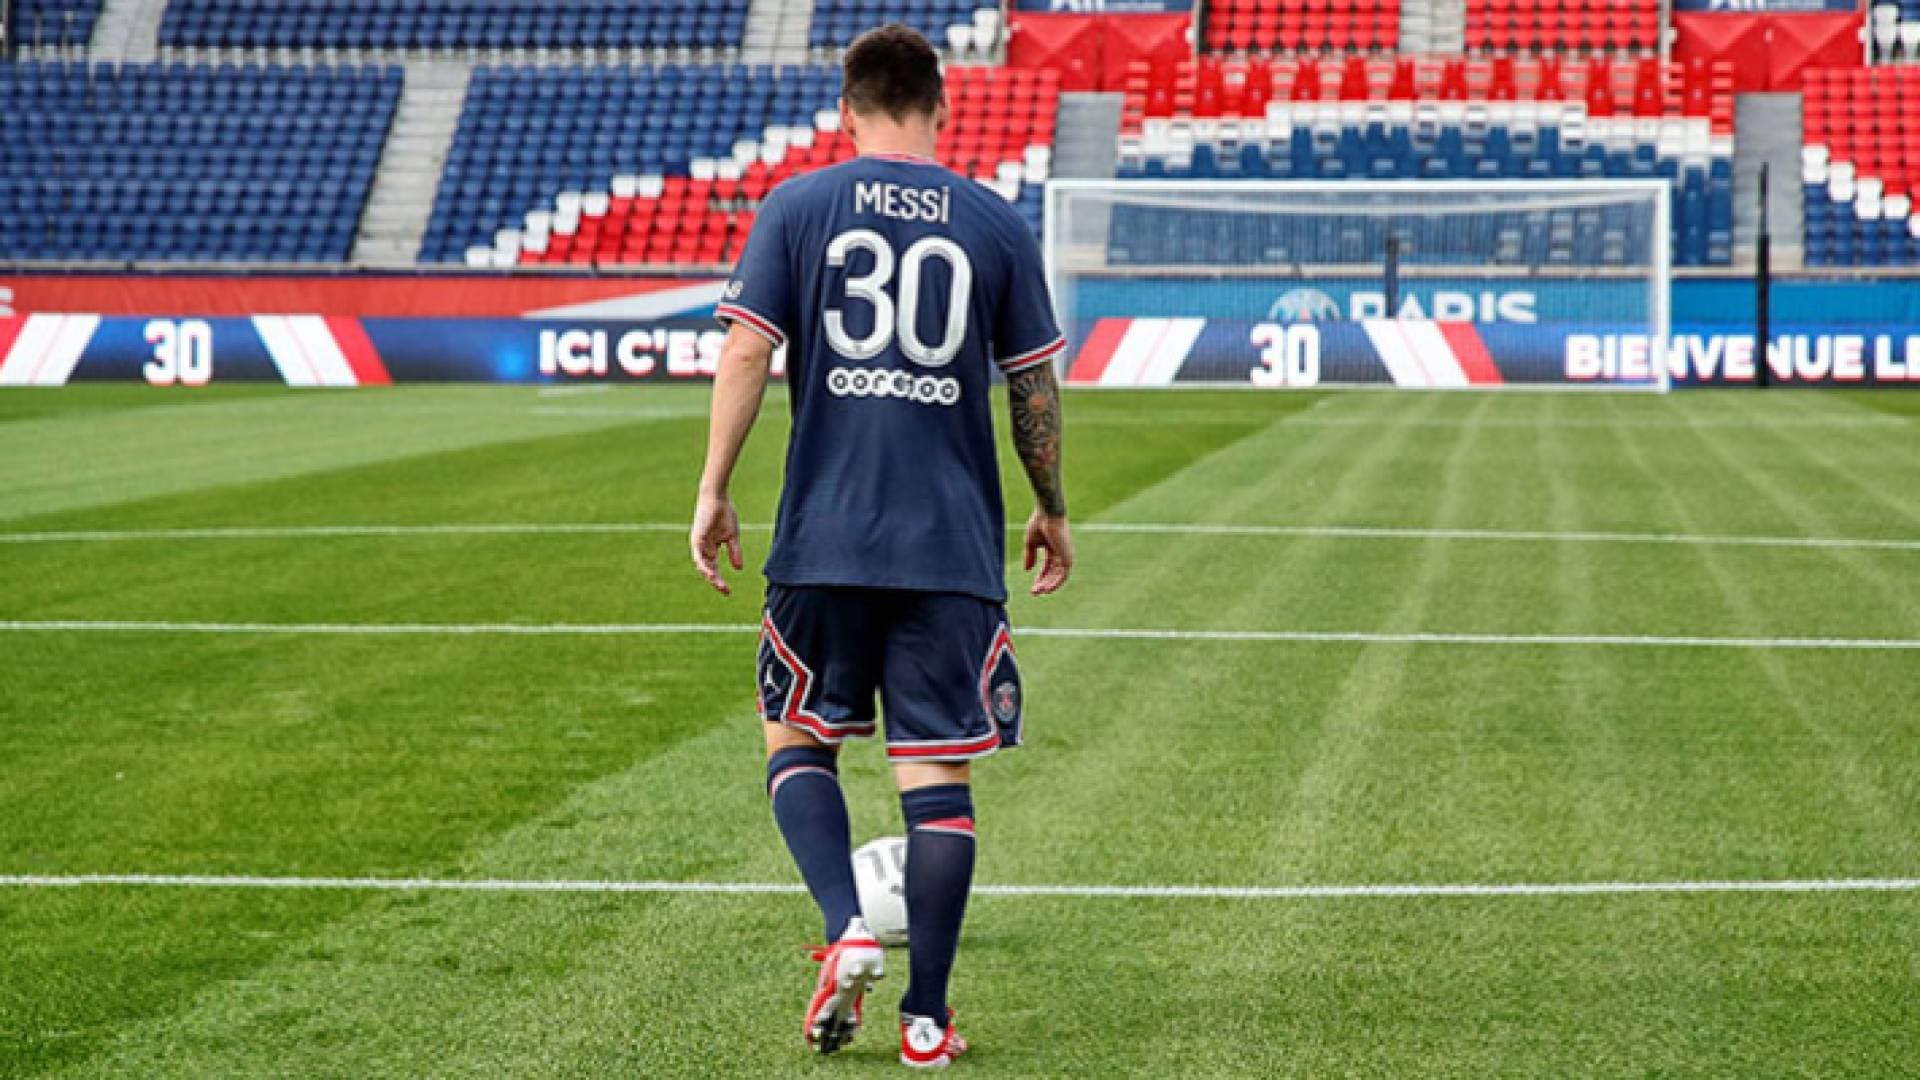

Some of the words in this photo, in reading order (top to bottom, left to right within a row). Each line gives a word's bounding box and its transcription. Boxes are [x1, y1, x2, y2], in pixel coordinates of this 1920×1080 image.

[823, 228, 973, 368] 30
[142, 317, 214, 388] 30
[538, 328, 609, 377] ICI
[616, 327, 730, 378] C'ES
[1250, 321, 1321, 387] 30
[1565, 333, 1865, 382] BIENVENUE
